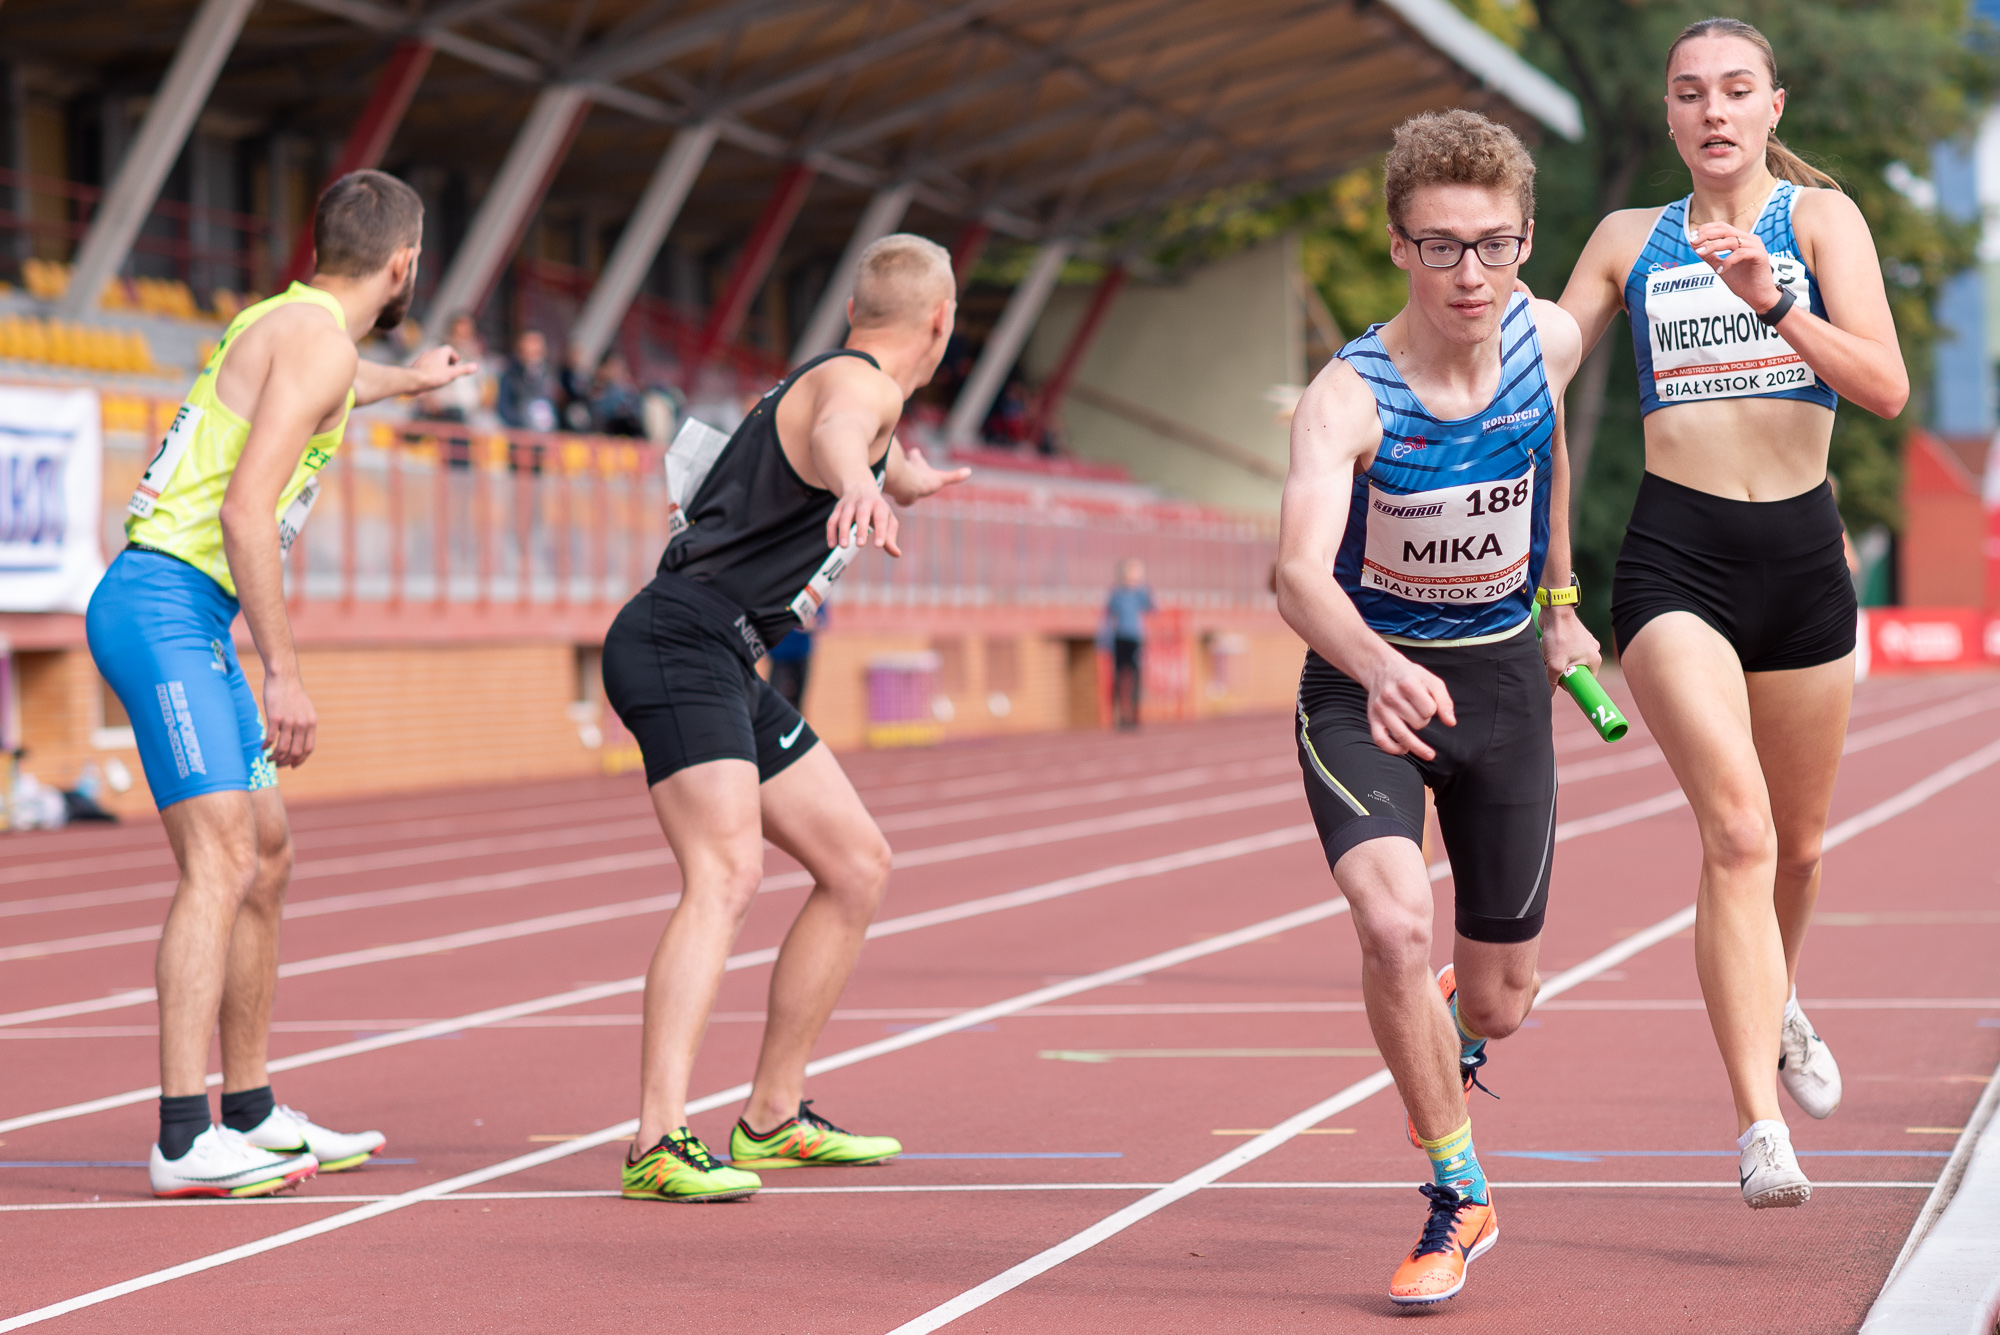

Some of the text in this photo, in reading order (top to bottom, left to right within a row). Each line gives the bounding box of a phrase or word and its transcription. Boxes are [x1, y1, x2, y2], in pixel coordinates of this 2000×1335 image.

[1655, 311, 1780, 353] WIERZCHOW
[1665, 367, 1807, 397] BIAŁYSTOK 2022
[1679, 364, 1731, 376] MISTRZOSTWA
[1731, 361, 1758, 371] POLSKI
[1759, 359, 1766, 367] W
[1465, 478, 1529, 518] 188
[1402, 532, 1503, 565] MIKA
[1373, 571, 1523, 600] BIAŁYSTOK 2022
[1389, 571, 1448, 584] MISTRZOSTWA
[1449, 576, 1478, 584] POLSKI
[1489, 556, 1528, 580] SZTAFETACH
[733, 615, 767, 660] NIKE
